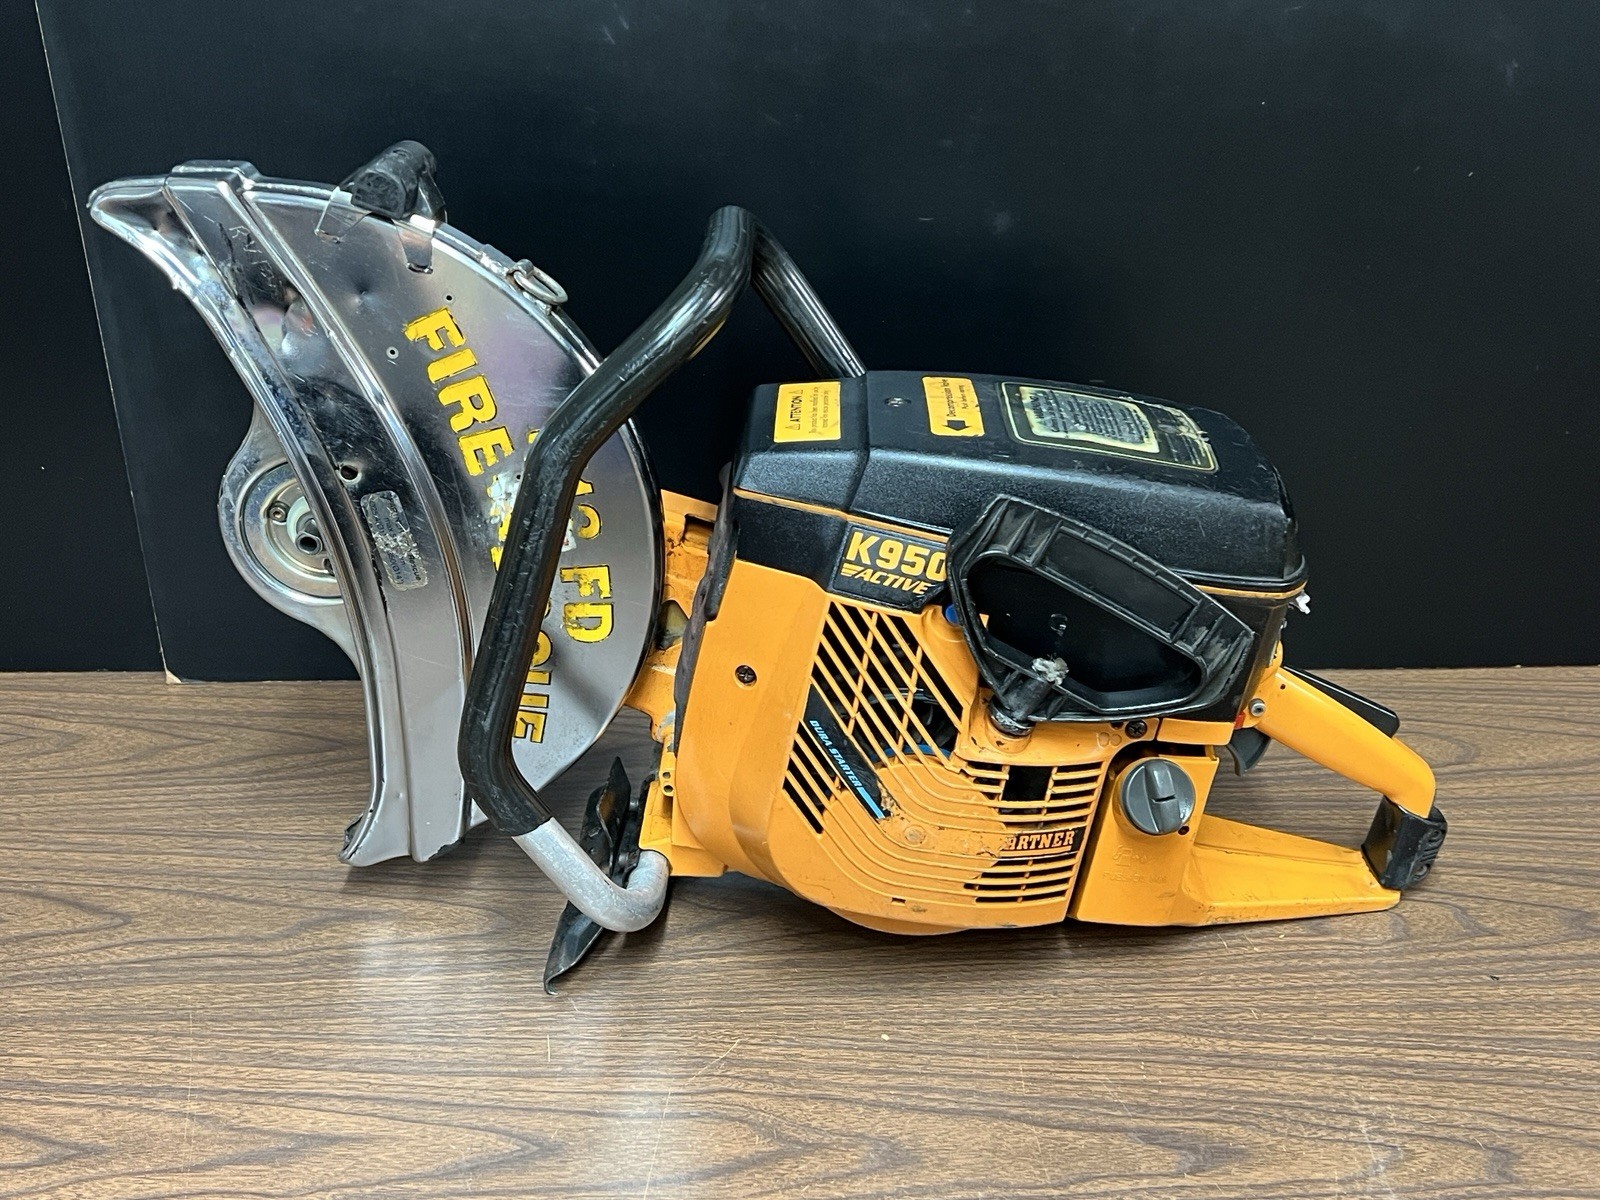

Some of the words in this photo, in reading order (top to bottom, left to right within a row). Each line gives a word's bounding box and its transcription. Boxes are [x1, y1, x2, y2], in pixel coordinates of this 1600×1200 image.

[402, 307, 515, 477] FIRE
[789, 395, 802, 423] ATTENTION
[560, 564, 614, 643] FD
[855, 568, 933, 594] ACTIVE
[809, 720, 833, 746] DURA
[828, 748, 863, 787] STARTER
[1006, 830, 1076, 850] ARTNER
